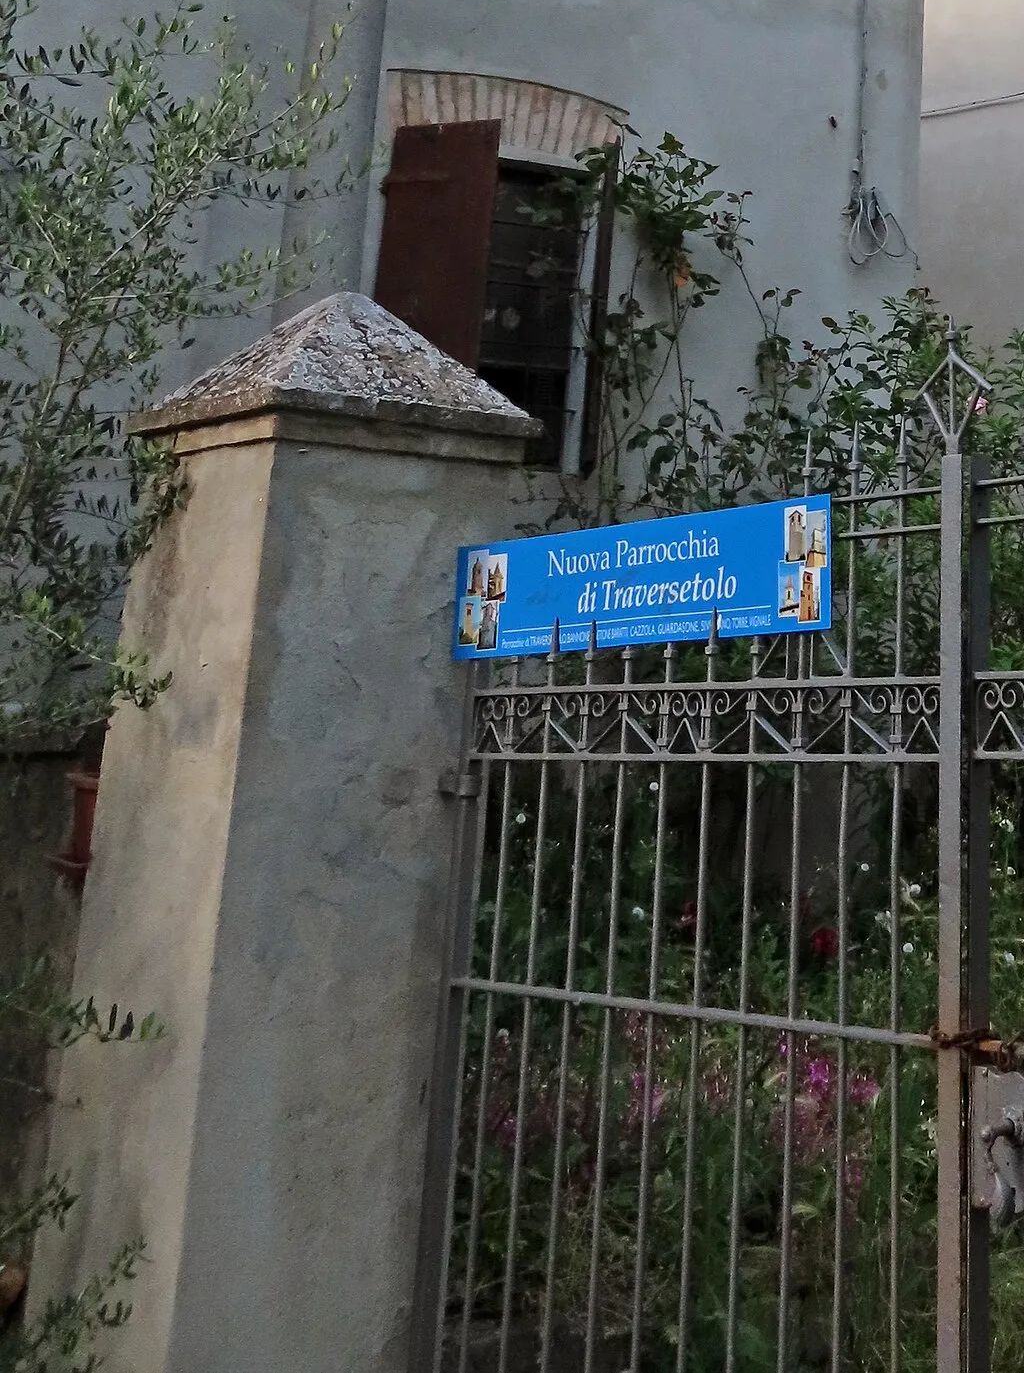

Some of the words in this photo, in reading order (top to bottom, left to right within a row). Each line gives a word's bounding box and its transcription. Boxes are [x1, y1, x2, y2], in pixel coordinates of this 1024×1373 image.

[547, 549, 610, 577] Nuova
[616, 529, 720, 566] Parrocchia
[577, 581, 597, 614] di
[601, 567, 737, 611] Traversetolo
